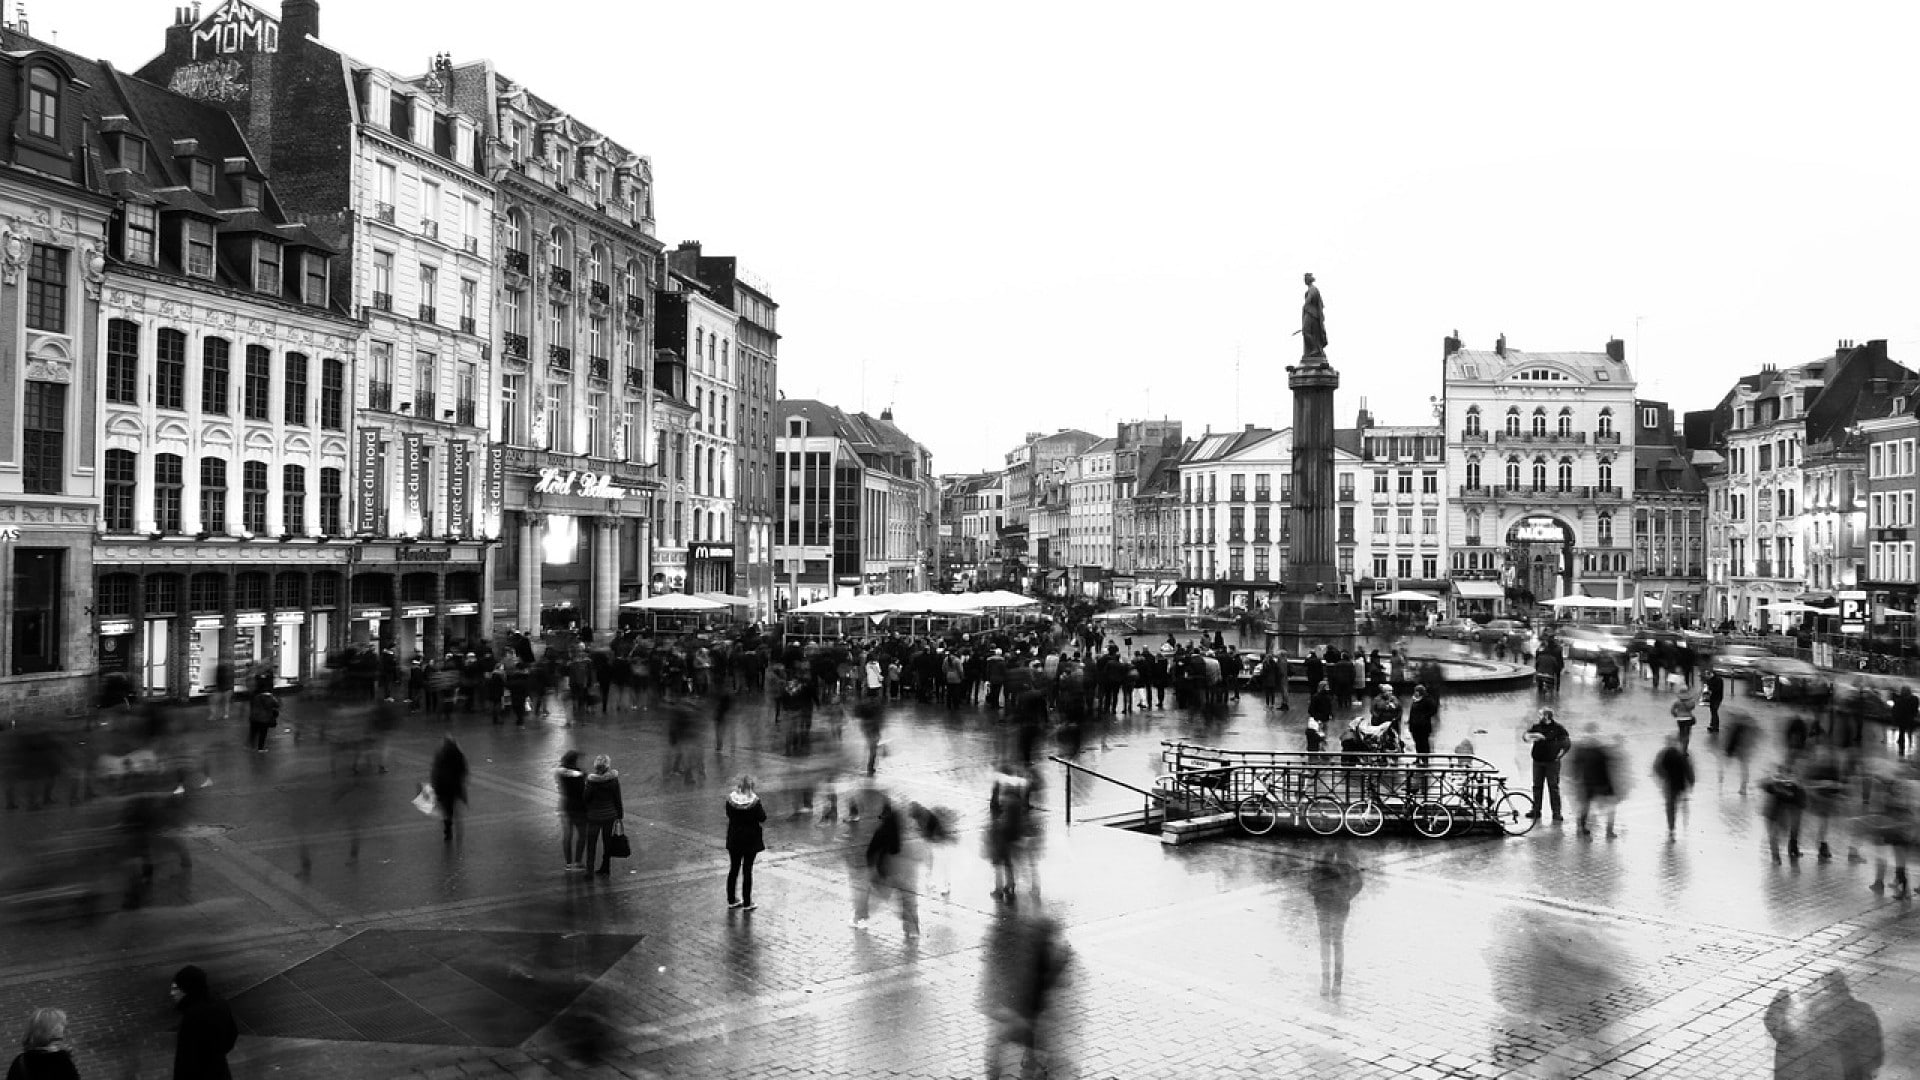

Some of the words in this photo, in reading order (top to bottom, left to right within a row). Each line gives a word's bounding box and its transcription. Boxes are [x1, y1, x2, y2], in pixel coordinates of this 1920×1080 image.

[214, 0, 254, 23] SAN
[192, 20, 279, 60] MOMO
[364, 431, 376, 466] nord
[407, 438, 420, 470] nord
[452, 443, 463, 474] nord
[363, 468, 374, 489] du
[491, 449, 502, 479] nord
[408, 472, 420, 492] du
[451, 476, 463, 496] du
[490, 481, 501, 498] du
[362, 490, 374, 529] Furet
[451, 497, 462, 534] Furet
